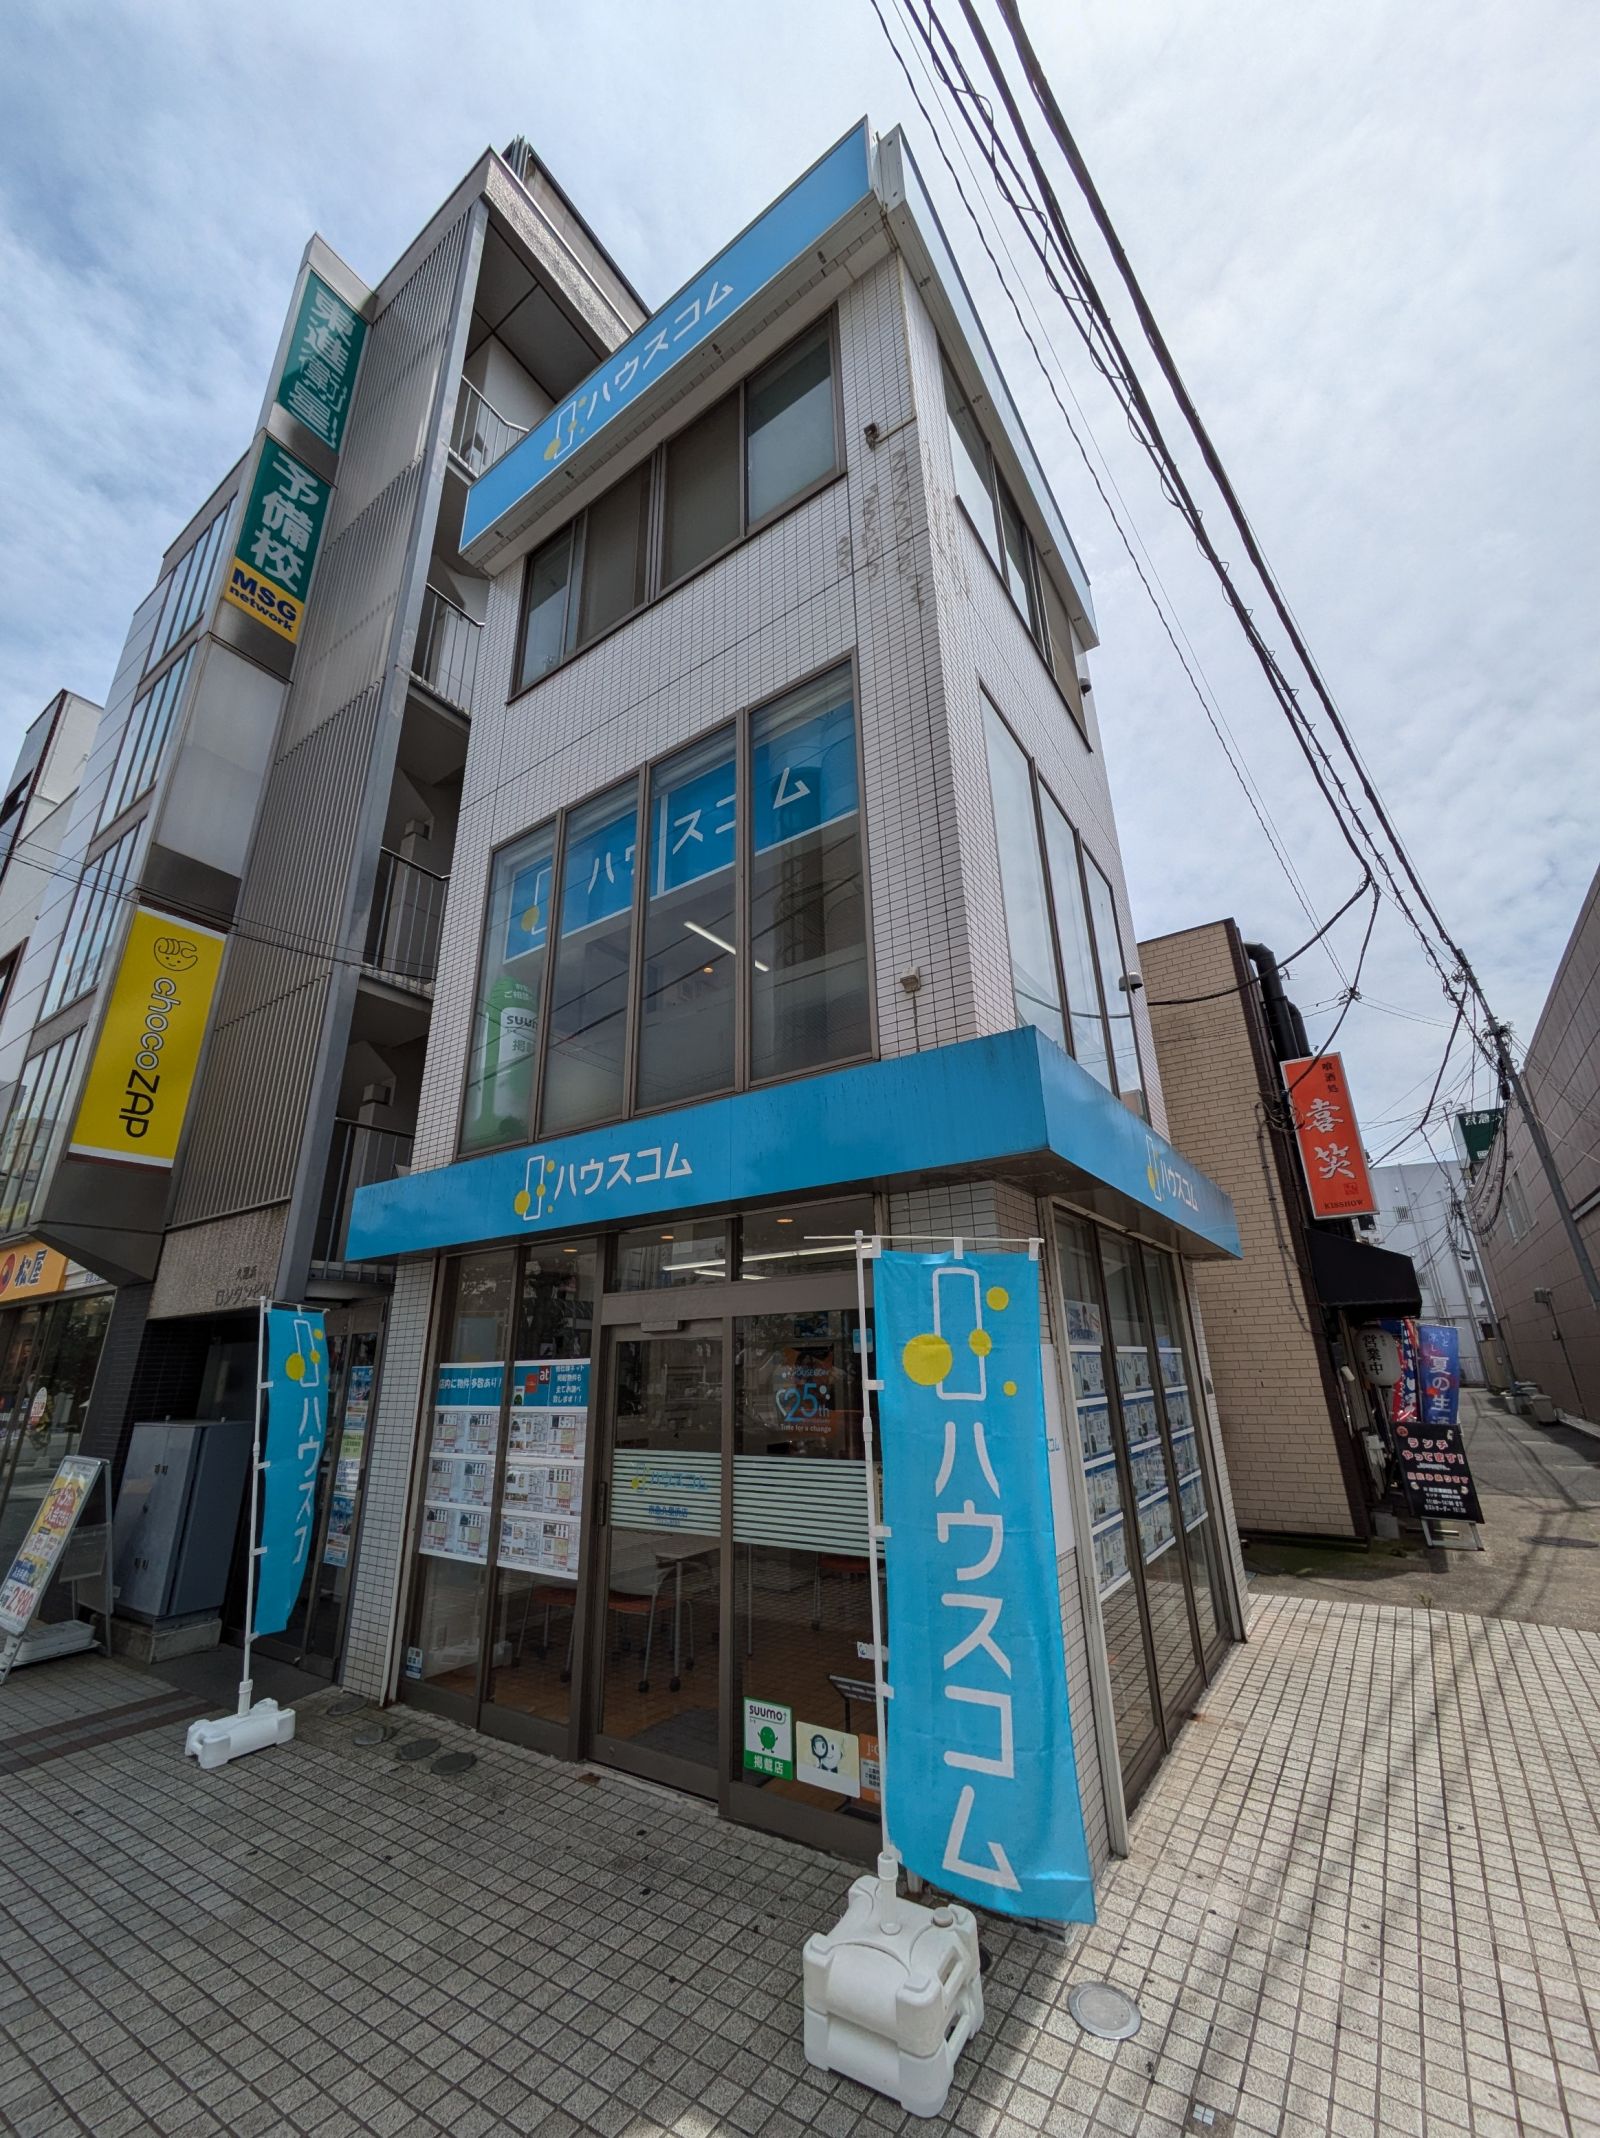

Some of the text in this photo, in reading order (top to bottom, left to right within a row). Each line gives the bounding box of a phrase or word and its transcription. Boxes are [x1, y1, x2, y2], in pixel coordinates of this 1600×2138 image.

[287, 286, 356, 449] 東進衛星
[587, 281, 734, 420] ハウスコム
[251, 451, 319, 592] 予備校
[229, 585, 294, 632] network
[232, 567, 297, 622] MSG
[119, 977, 181, 1138] chocoZAP
[1305, 1098, 1355, 1179] 喜笑
[554, 1142, 693, 1200] ハウスコム
[1160, 1159, 1199, 1211] ハウスコム
[1324, 1200, 1364, 1210] KISSHOW
[15, 1249, 48, 1287] 松屋
[539, 1368, 550, 1381] at
[1363, 1334, 1383, 1375] 営業中
[810, 1425, 832, 1433] change
[1407, 1437, 1448, 1450] ランチ
[1402, 1450, 1464, 1464] やってます!
[934, 1420, 1023, 1893] ハウスコム
[749, 1704, 783, 1721] suumo
[753, 1754, 784, 1775] 掲載店
